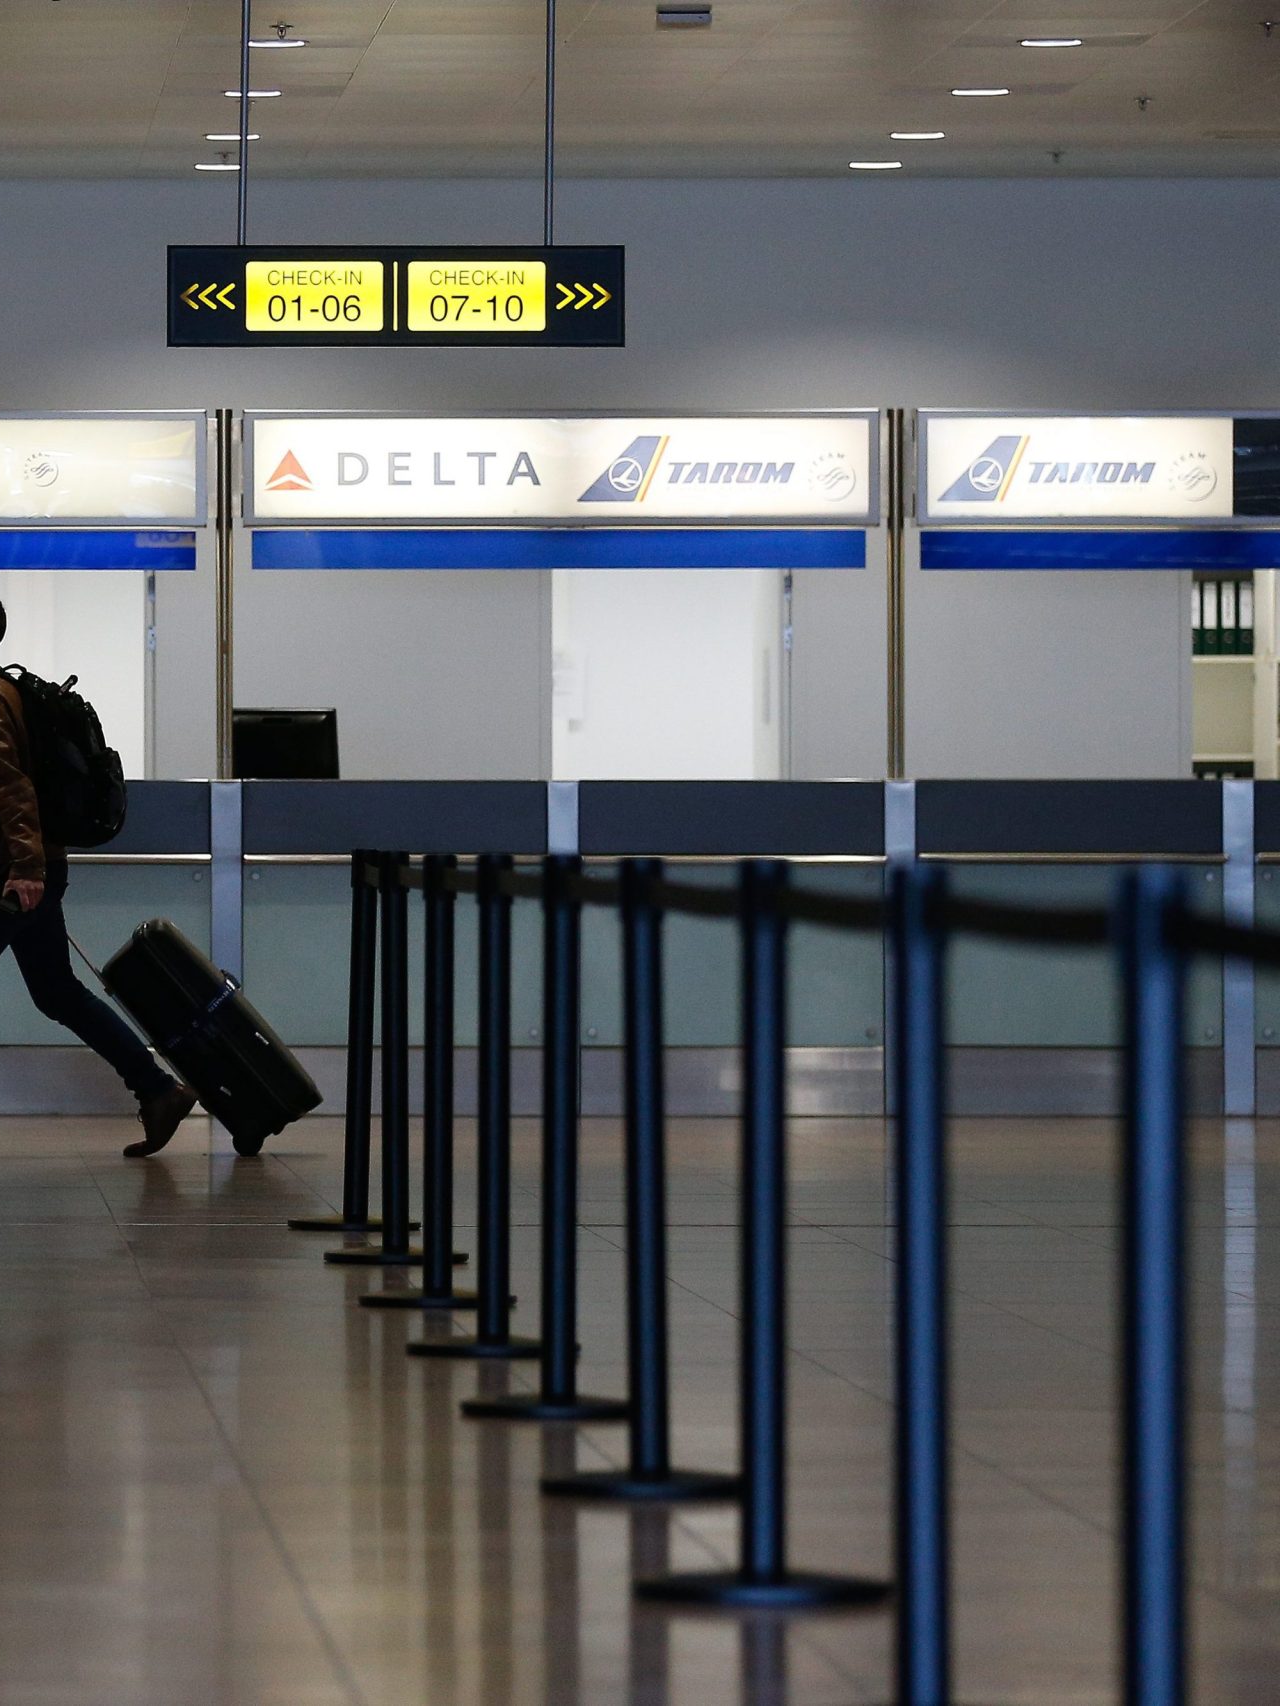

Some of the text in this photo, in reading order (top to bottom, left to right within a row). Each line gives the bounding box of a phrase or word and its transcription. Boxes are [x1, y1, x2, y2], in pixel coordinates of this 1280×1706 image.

[267, 270, 363, 286] CHECK-IN
[429, 270, 525, 286] CHECK-IN
[267, 294, 362, 322] 01-06
[429, 294, 524, 322] 07-10
[337, 451, 542, 486] DELTA
[667, 461, 796, 485] TAROM
[1028, 461, 1157, 485] TAROM
